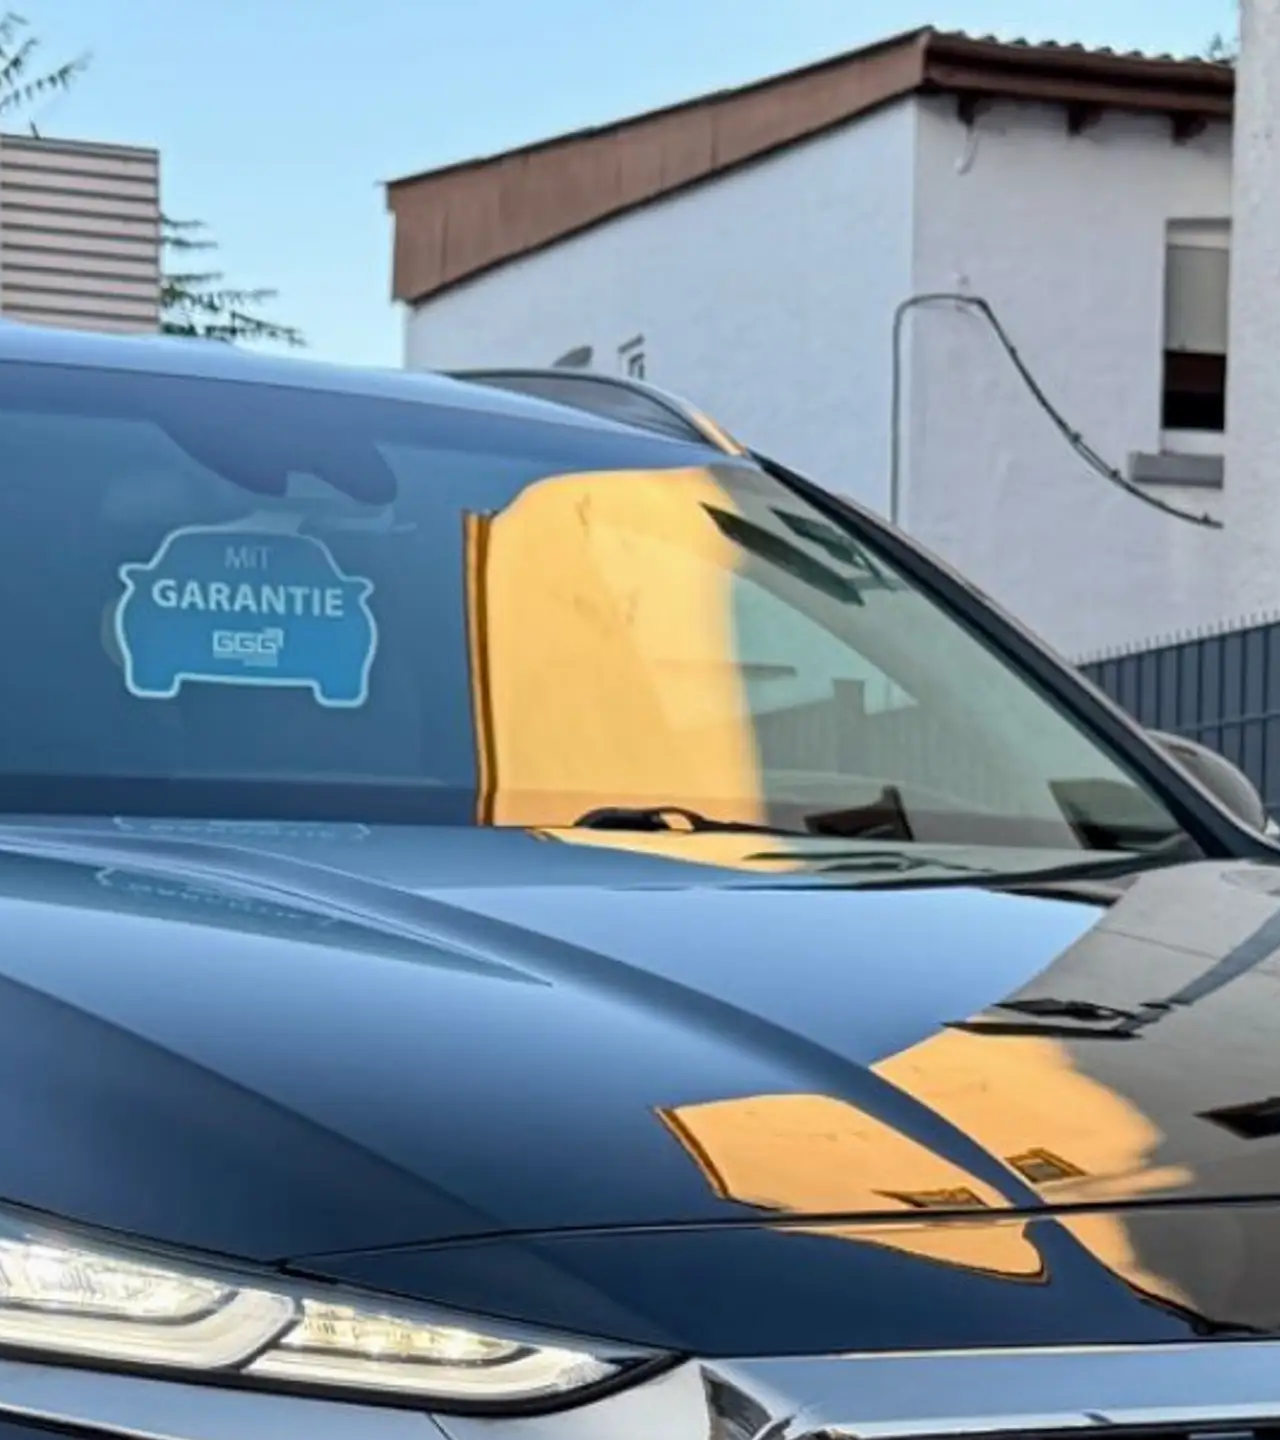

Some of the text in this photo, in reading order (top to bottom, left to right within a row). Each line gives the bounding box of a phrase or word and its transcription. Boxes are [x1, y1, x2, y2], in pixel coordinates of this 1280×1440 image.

[225, 546, 270, 571] MIT
[152, 579, 345, 617] GARANTIE
[214, 631, 277, 653] GGG
